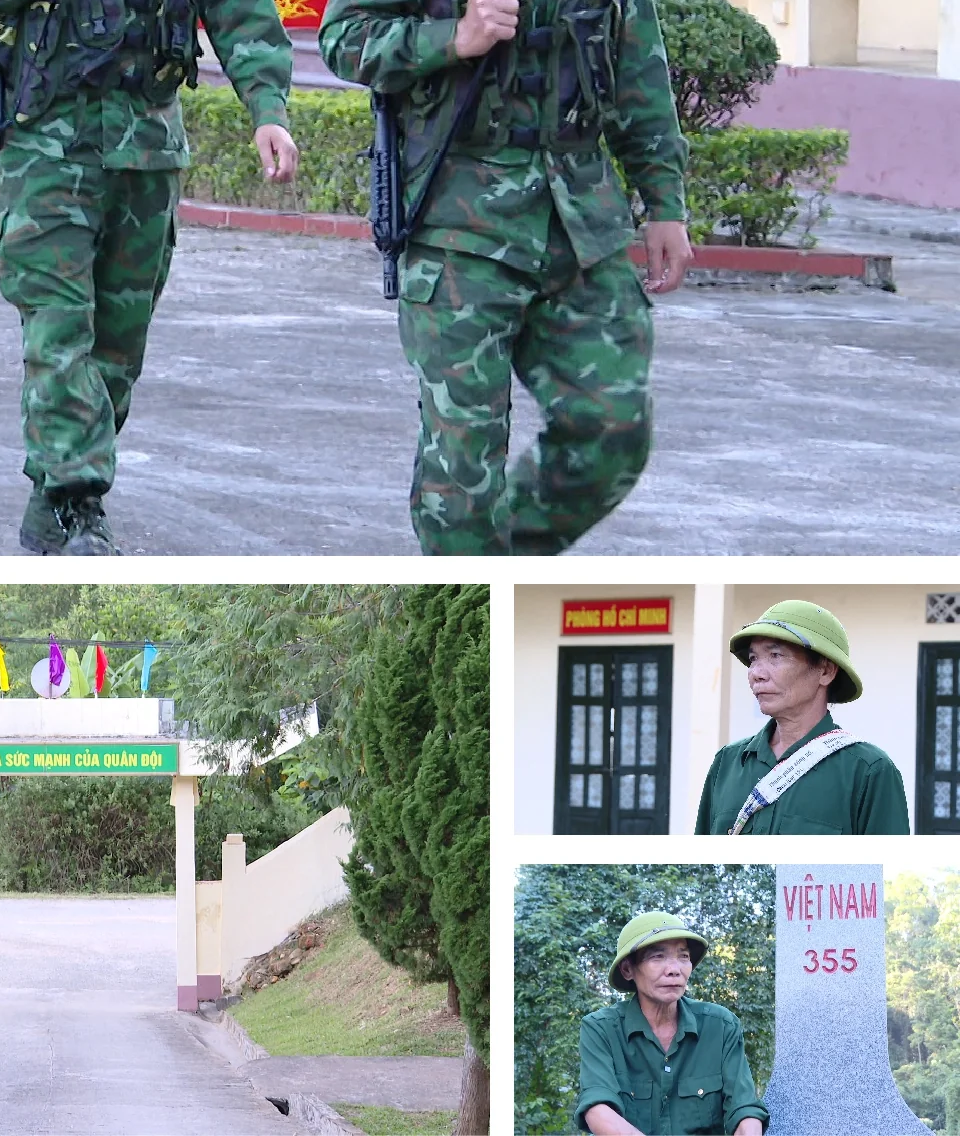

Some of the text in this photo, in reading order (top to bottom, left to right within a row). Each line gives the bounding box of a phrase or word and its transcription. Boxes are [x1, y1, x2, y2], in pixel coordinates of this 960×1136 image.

[5, 750, 30, 767] SỨC
[33, 753, 71, 770] MẠNH
[74, 748, 100, 767] CỦA
[103, 750, 138, 768] QUÂN
[141, 750, 162, 770] ĐỘI
[783, 873, 877, 932] VIỆT NAM
[803, 948, 858, 975] 355
